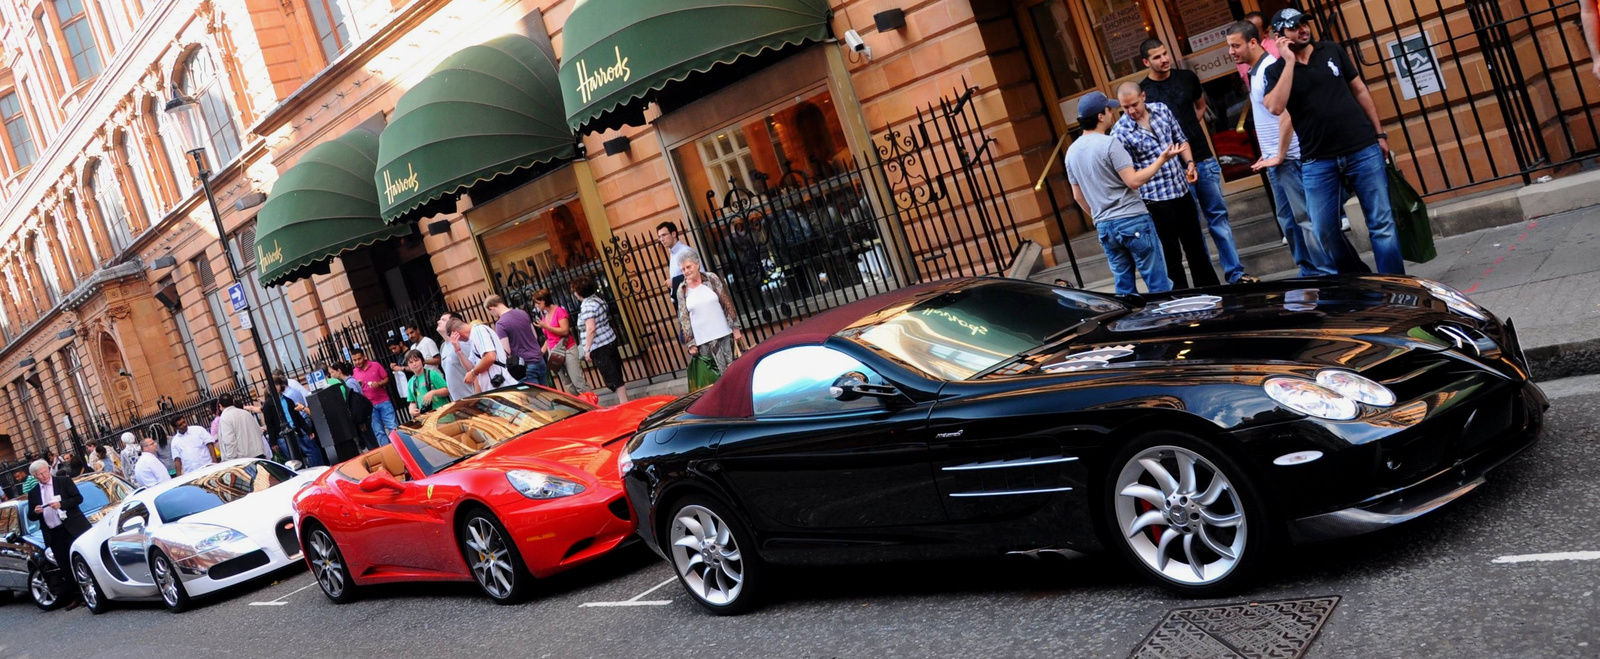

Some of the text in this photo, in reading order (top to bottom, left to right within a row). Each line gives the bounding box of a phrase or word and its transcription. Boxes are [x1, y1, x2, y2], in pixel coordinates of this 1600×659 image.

[1102, 4, 1137, 23] LATE NIGHT
[1103, 12, 1140, 30] SHOPPING
[576, 46, 630, 104] Harrods
[1193, 57, 1221, 75] Food
[384, 162, 418, 204] Harrods
[258, 240, 282, 274] Harrods
